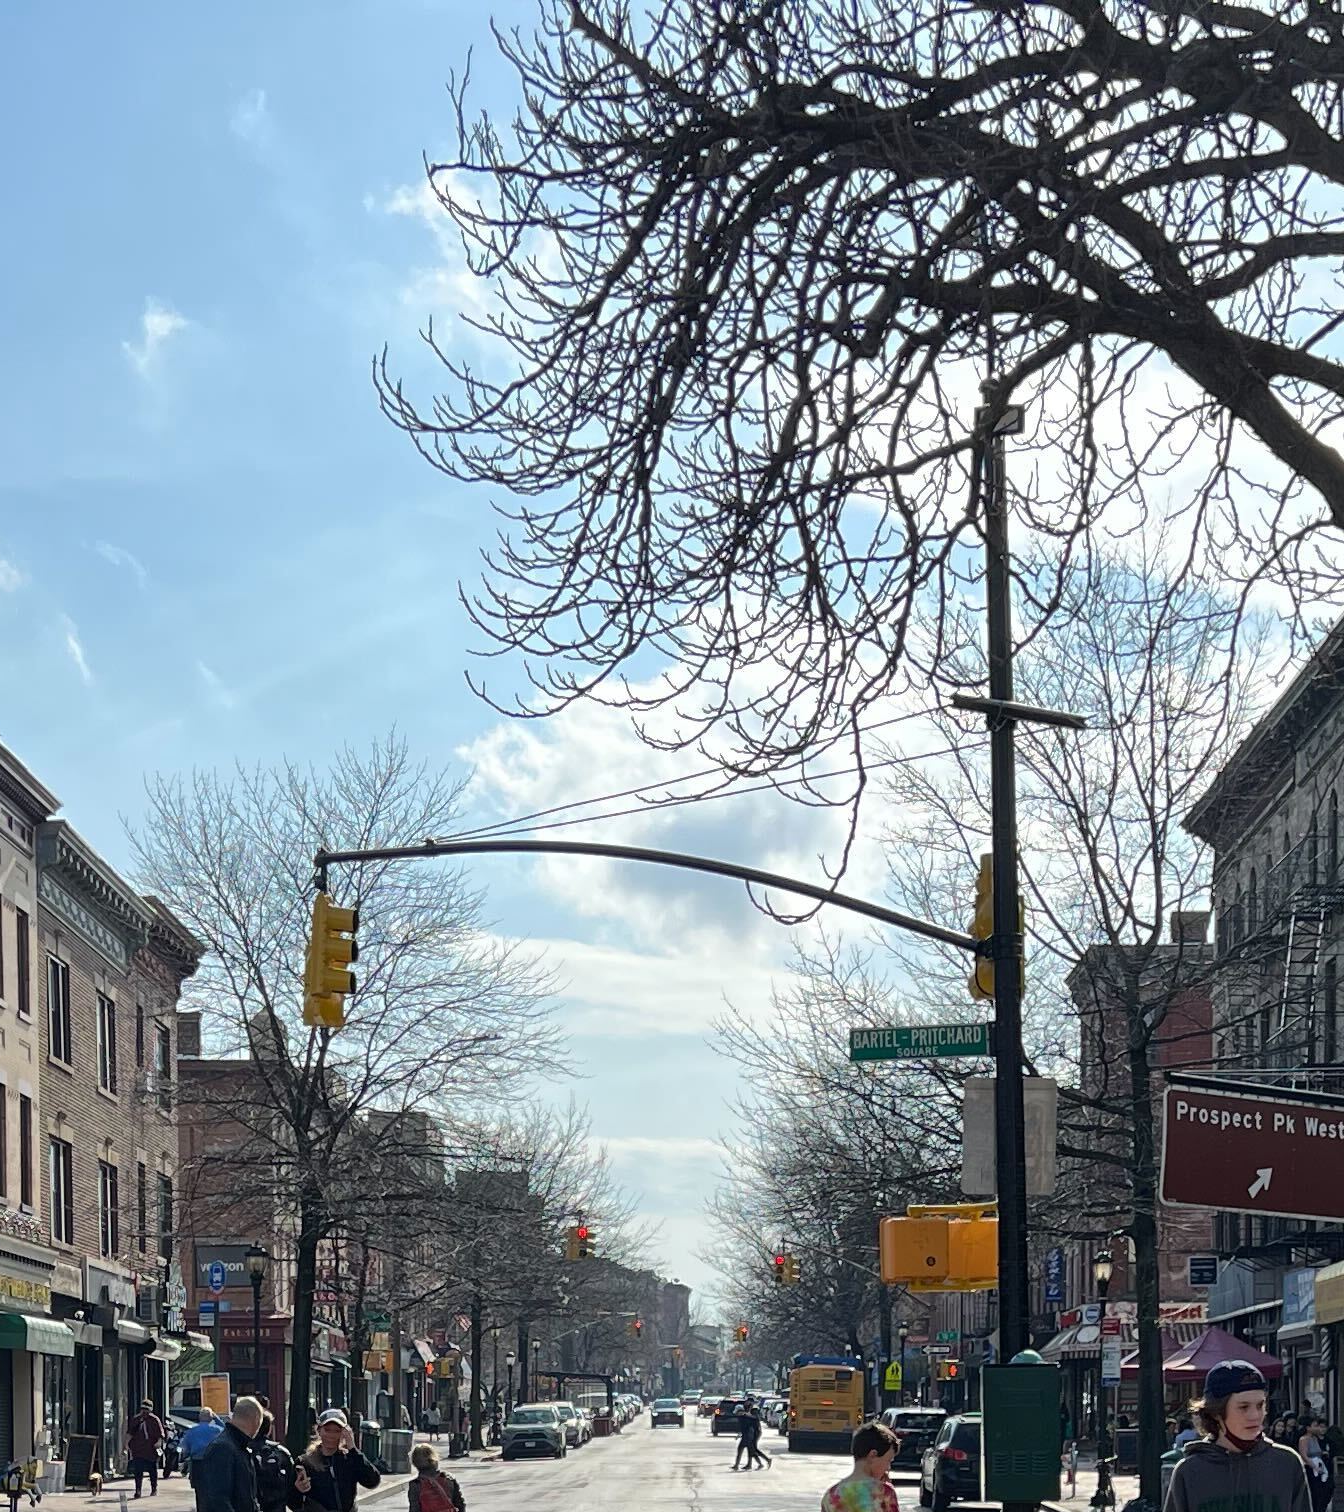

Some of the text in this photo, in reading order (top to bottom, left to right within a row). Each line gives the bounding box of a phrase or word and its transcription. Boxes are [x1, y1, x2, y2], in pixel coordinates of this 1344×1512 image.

[896, 1046, 939, 1057] SQUARE
[1176, 1100, 1263, 1131] Prospect
[1273, 1112, 1296, 1134] Pk
[200, 1262, 244, 1272] vzon
